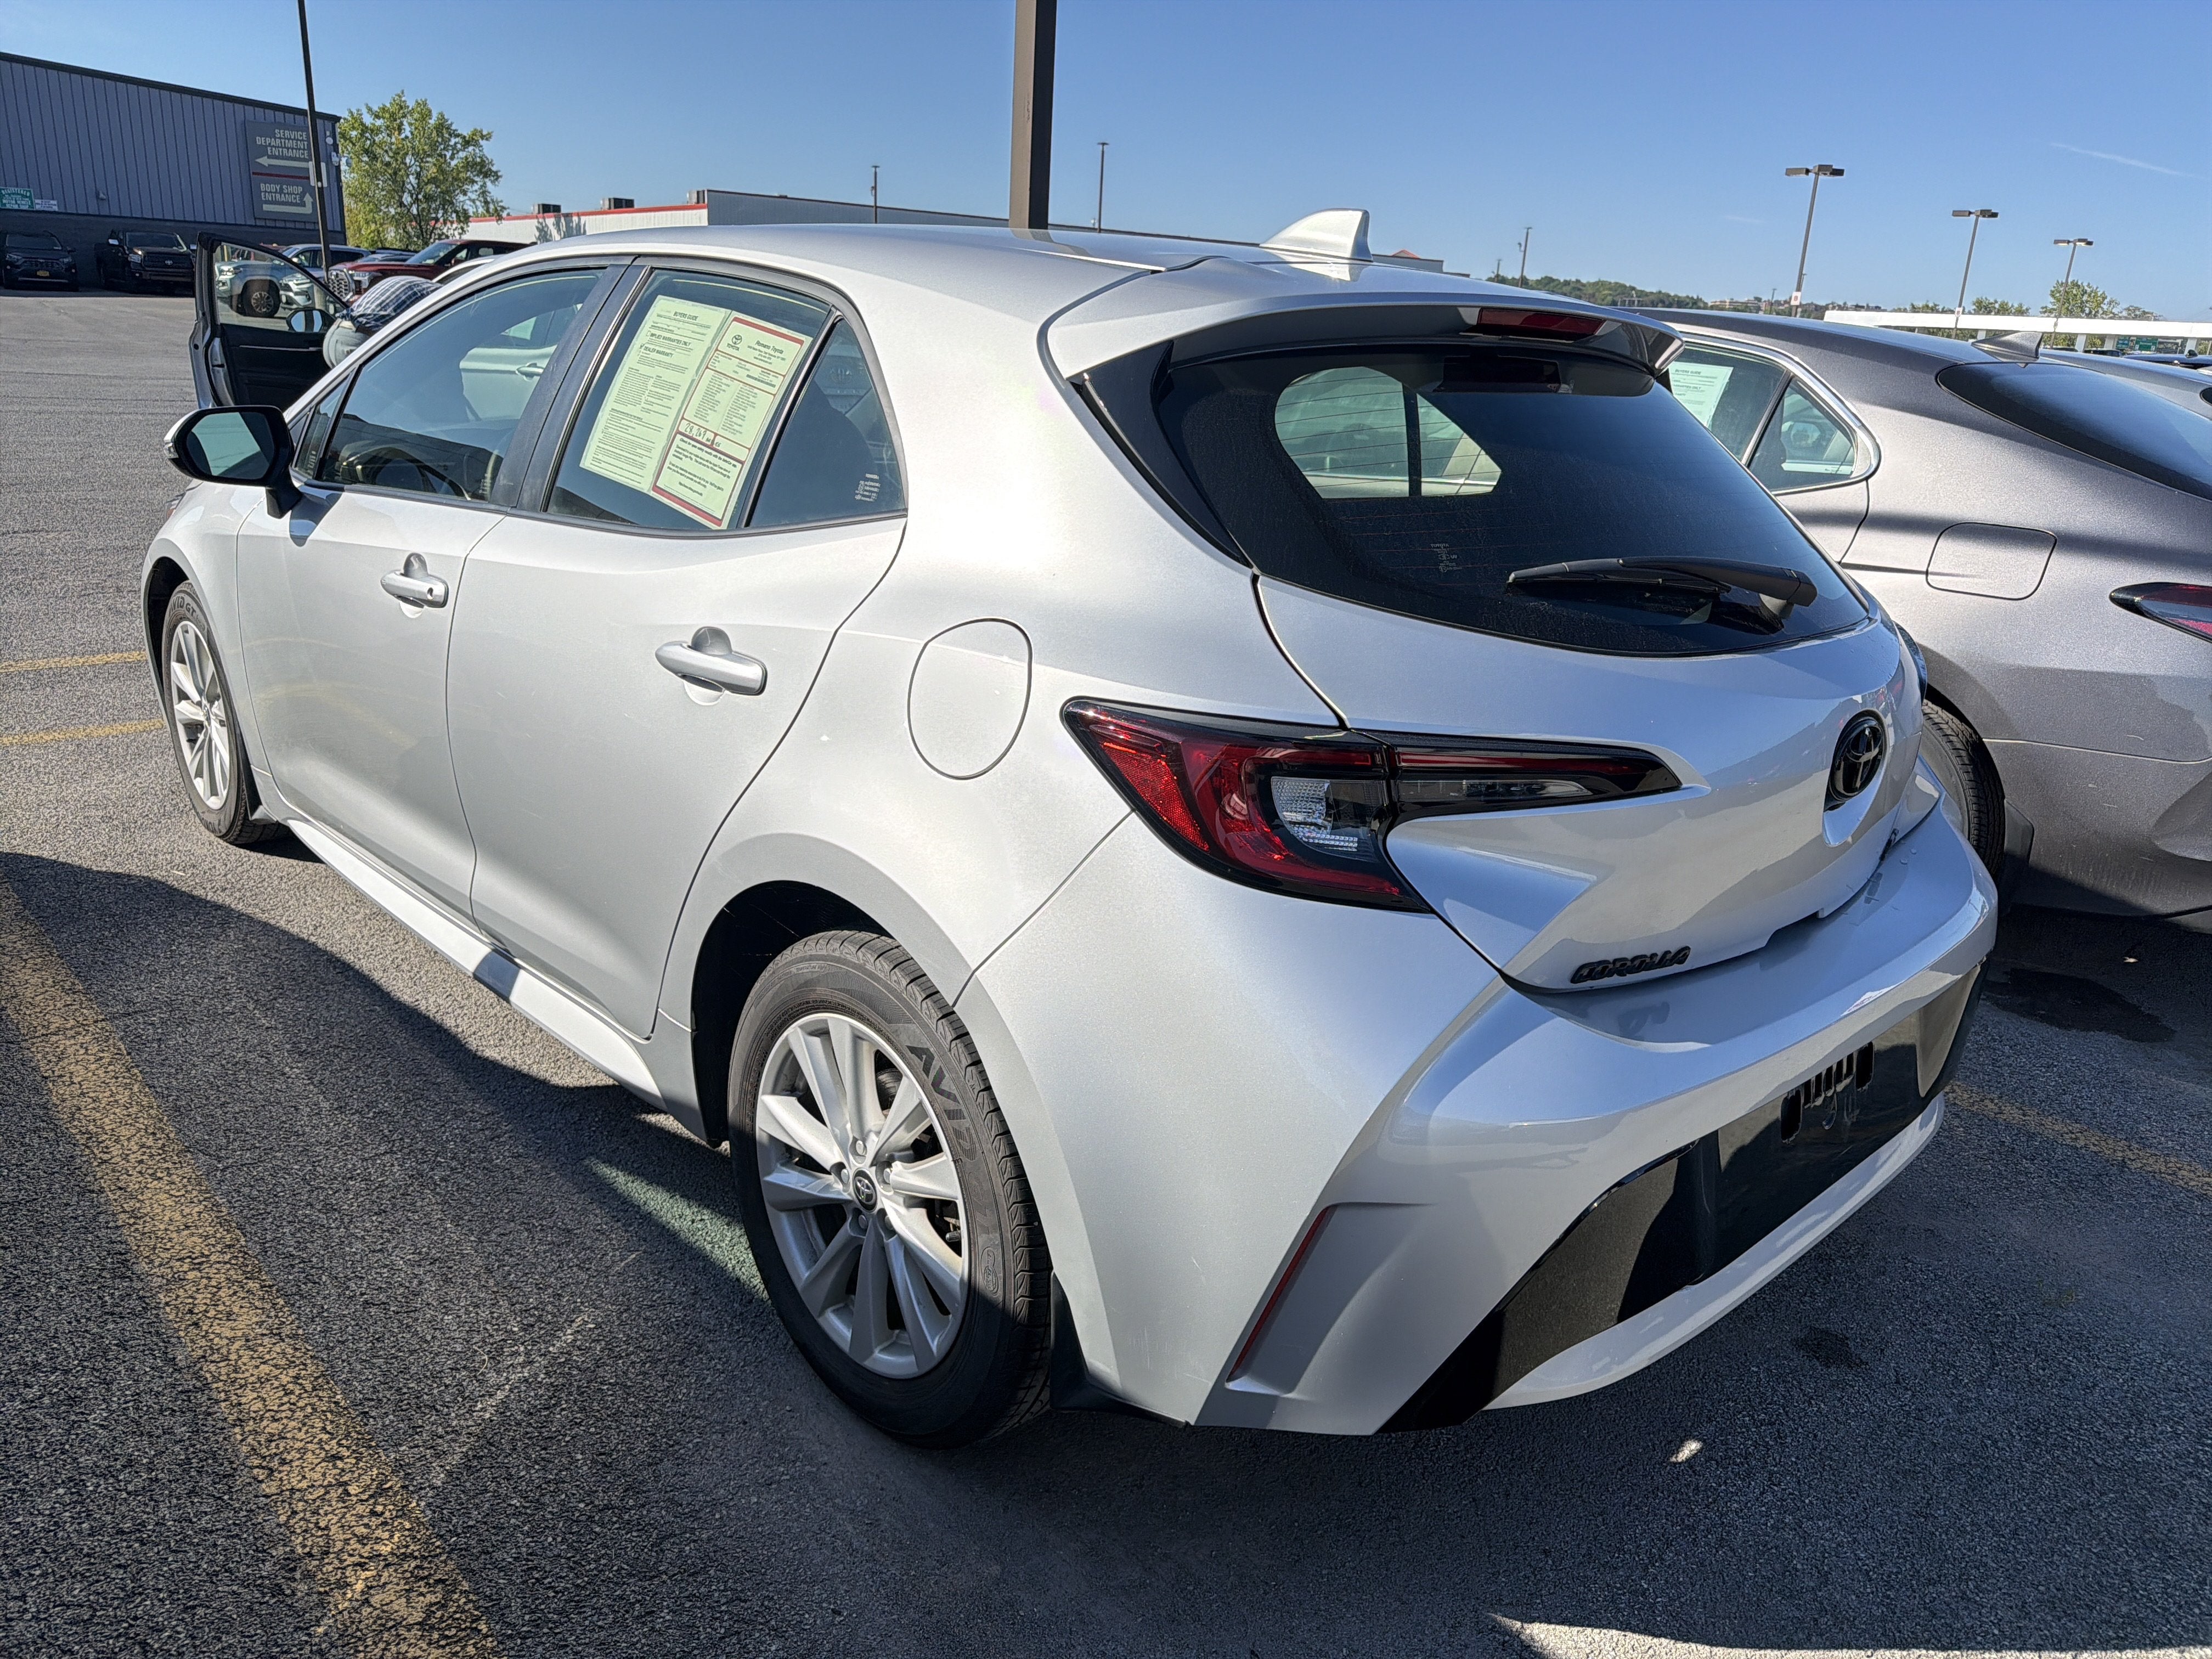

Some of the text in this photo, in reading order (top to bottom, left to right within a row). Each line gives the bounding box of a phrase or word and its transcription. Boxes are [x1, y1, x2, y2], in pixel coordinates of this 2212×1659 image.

[275, 129, 307, 140] SERVICE
[256, 136, 308, 149] DEPARTMENT
[267, 146, 309, 159] ENTRANCE
[260, 183, 303, 194] BODY SHOP
[261, 193, 301, 203] ENTRANCE
[662, 334, 682, 345] WARRANTIES
[644, 345, 657, 353] DEALER
[656, 348, 674, 357] WARRANTY
[727, 343, 740, 351] TOYOTA
[771, 345, 785, 354] Toyota
[168, 595, 197, 618] AVID GT
[1570, 946, 1691, 984] COROLLA
[905, 1045, 978, 1161] AVID
